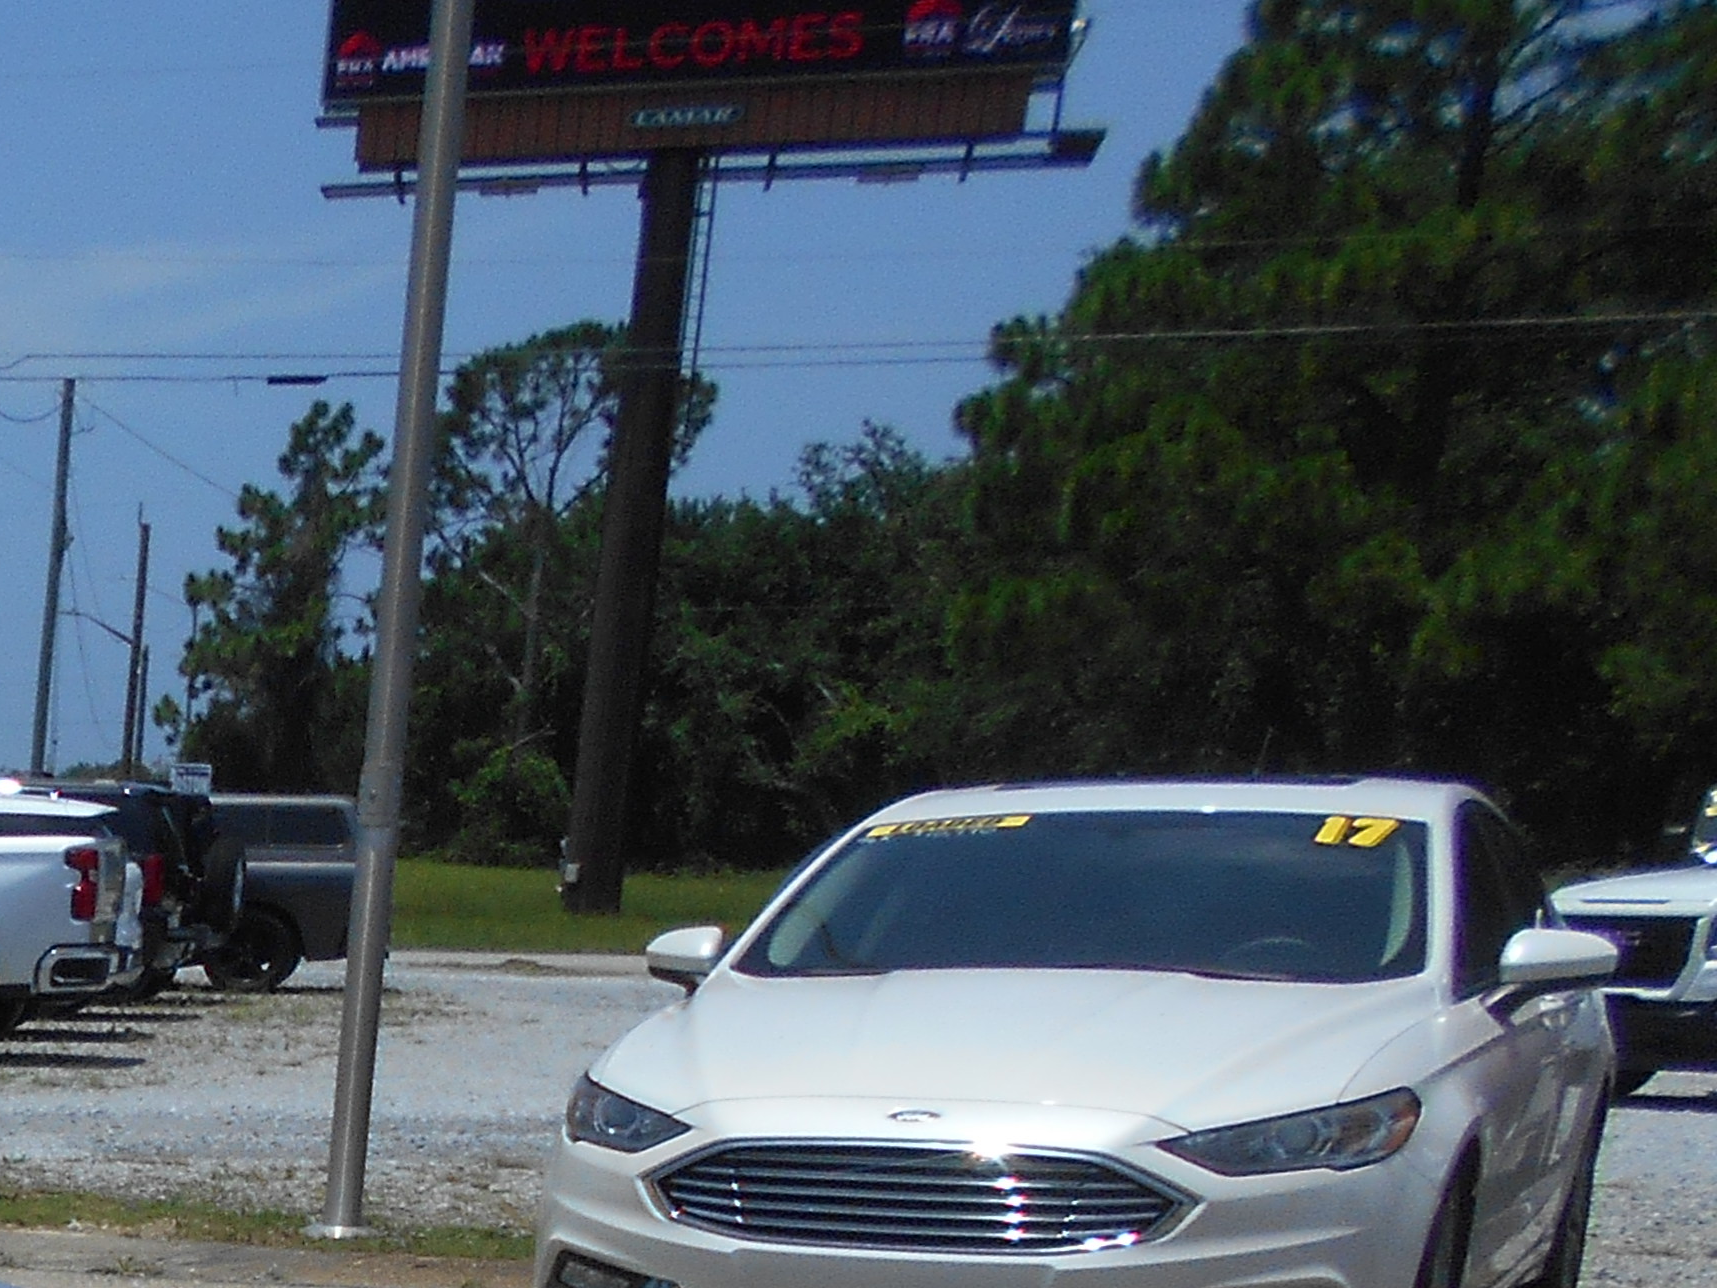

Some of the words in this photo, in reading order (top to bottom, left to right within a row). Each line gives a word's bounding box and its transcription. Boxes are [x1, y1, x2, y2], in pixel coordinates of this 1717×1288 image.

[382, 44, 505, 73] AMEAN
[524, 11, 865, 74] WELCOMES
[1313, 815, 1401, 848] 17
